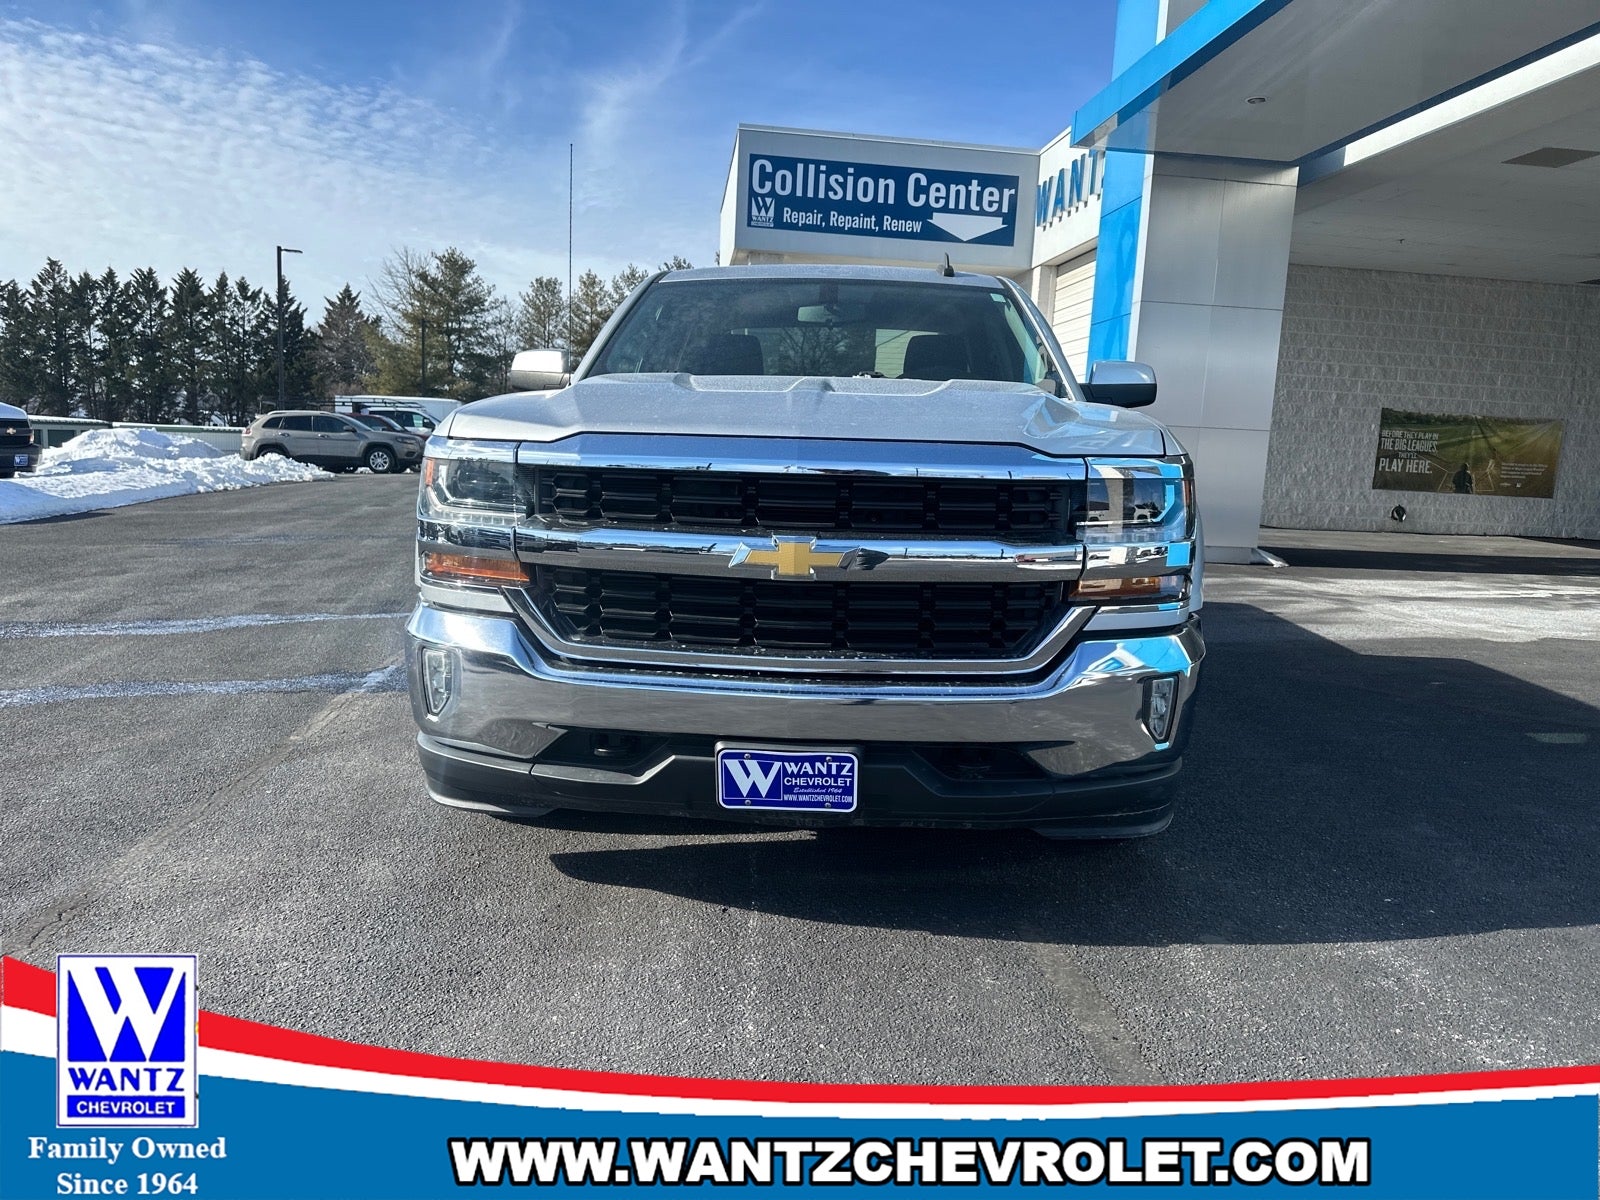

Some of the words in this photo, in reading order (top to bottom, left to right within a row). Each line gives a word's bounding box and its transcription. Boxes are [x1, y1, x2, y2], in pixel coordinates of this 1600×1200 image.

[752, 159, 896, 204] Collision
[906, 172, 1015, 213] Center
[1036, 150, 1105, 227] WANT
[783, 207, 825, 227] Repair,
[830, 213, 879, 232] Repaint,
[883, 216, 922, 233] Renew
[1381, 438, 1394, 449] THE
[1395, 439, 1407, 450] BIG
[1379, 458, 1404, 472] PLAY
[1405, 459, 1433, 474] HERE.
[784, 761, 853, 776] WANTZ
[724, 759, 782, 798] W
[784, 777, 852, 787] CHEVROLET
[783, 794, 853, 803] WWW.WANTZCHEVROLET.COM
